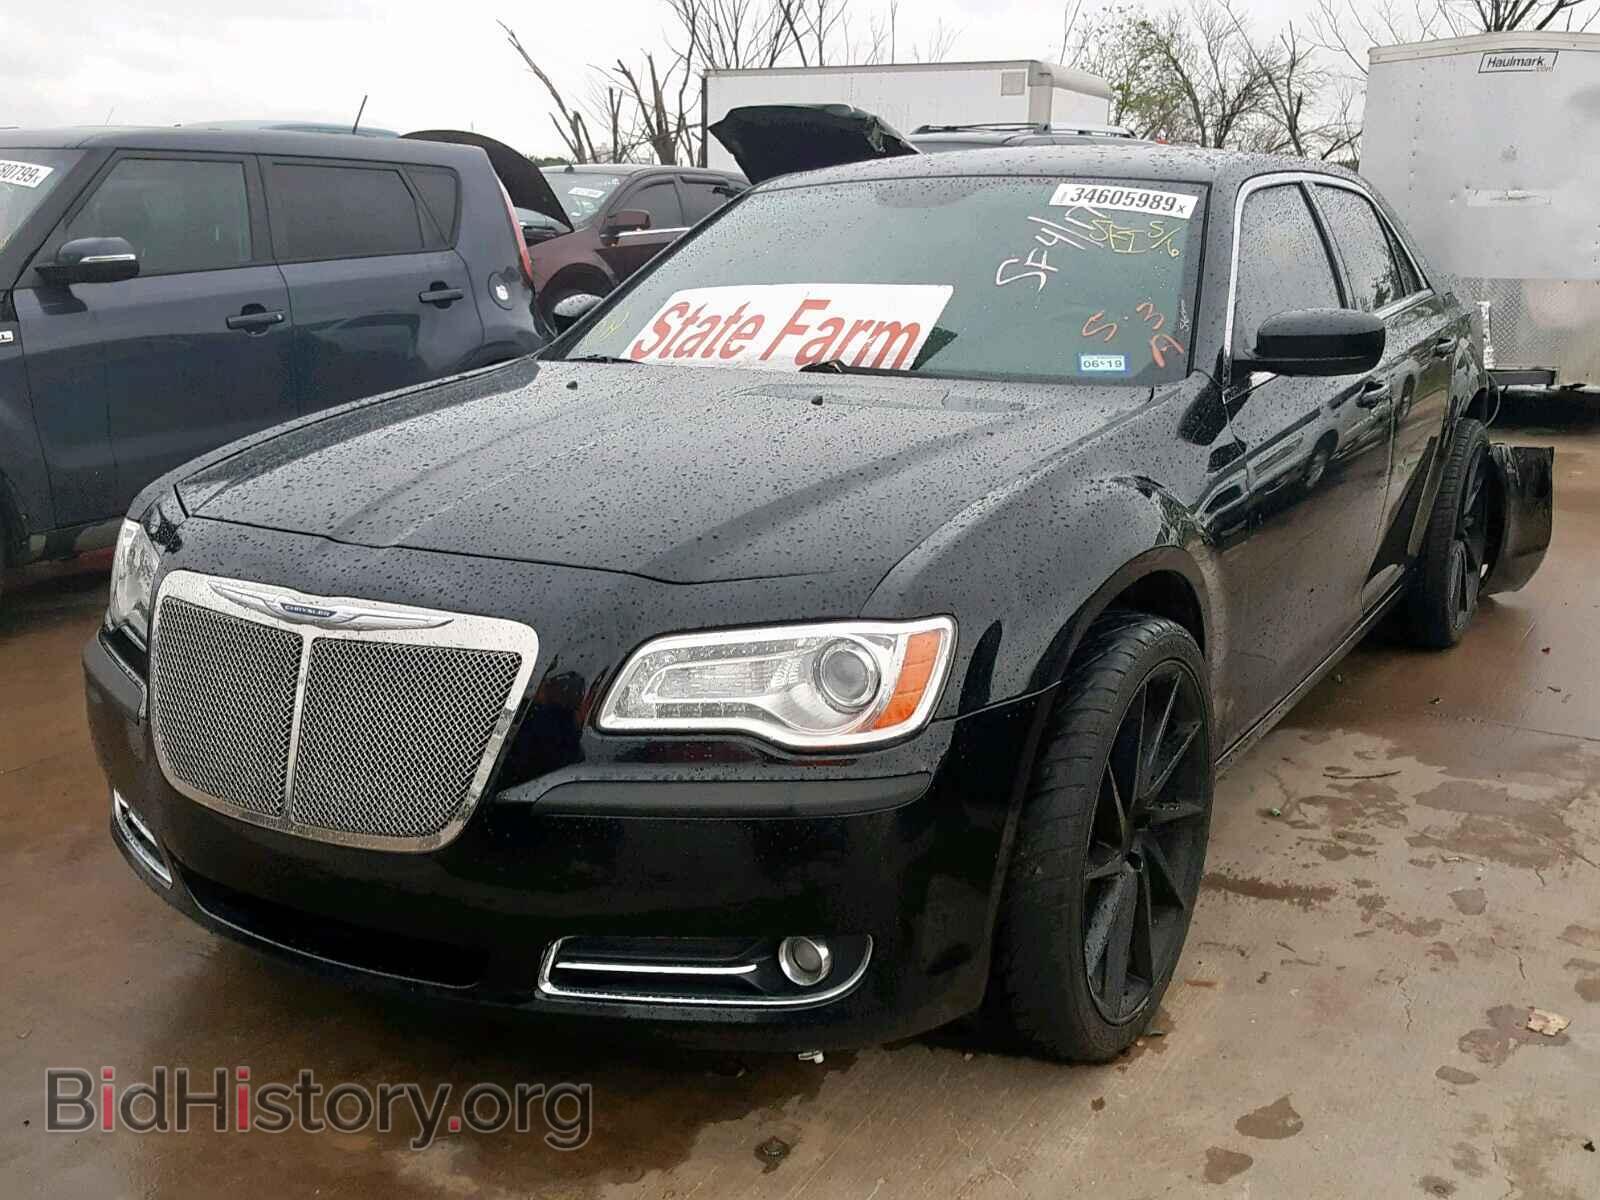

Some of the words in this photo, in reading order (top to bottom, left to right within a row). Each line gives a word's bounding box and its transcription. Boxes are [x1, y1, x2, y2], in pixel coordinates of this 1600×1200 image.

[1487, 55, 1545, 68] Haulmark
[630, 300, 766, 360] State
[759, 299, 921, 369] Farm
